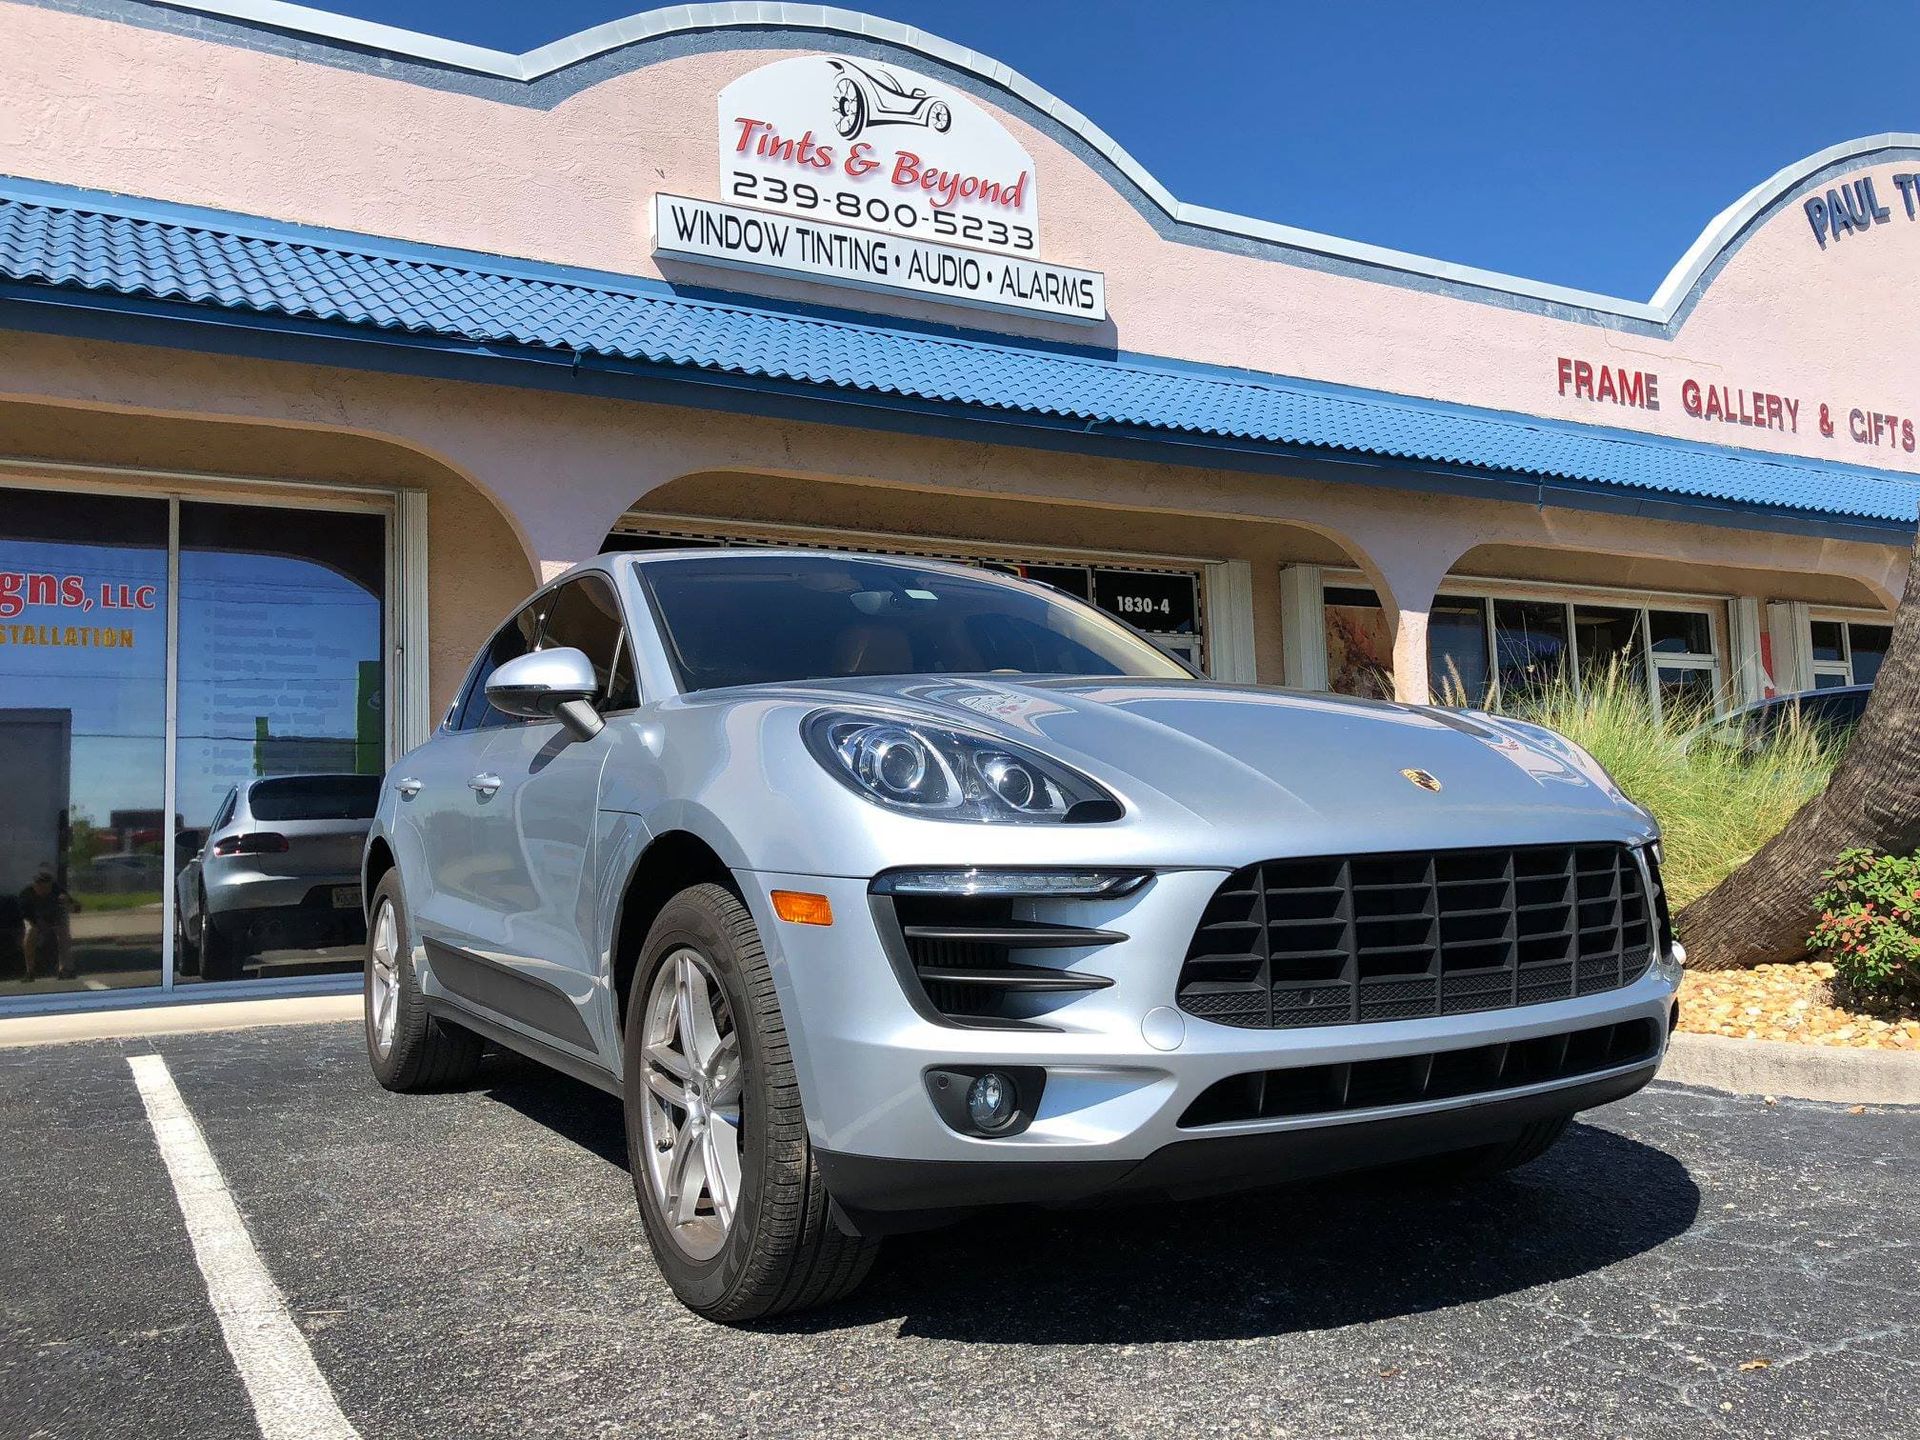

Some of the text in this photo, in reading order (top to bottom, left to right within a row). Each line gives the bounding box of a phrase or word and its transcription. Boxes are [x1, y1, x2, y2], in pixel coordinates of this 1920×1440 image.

[734, 117, 1027, 209] Tints & Beyond
[733, 171, 1034, 250] 239-800-5233
[1803, 176, 1891, 250] PAUL
[671, 204, 1093, 310] WINDOW TINTING AUDIO ALARMS
[1557, 357, 1916, 452] FRAME GALLERY & GIFTS
[100, 583, 157, 610] LLC
[1117, 596, 1169, 614] 1830-4
